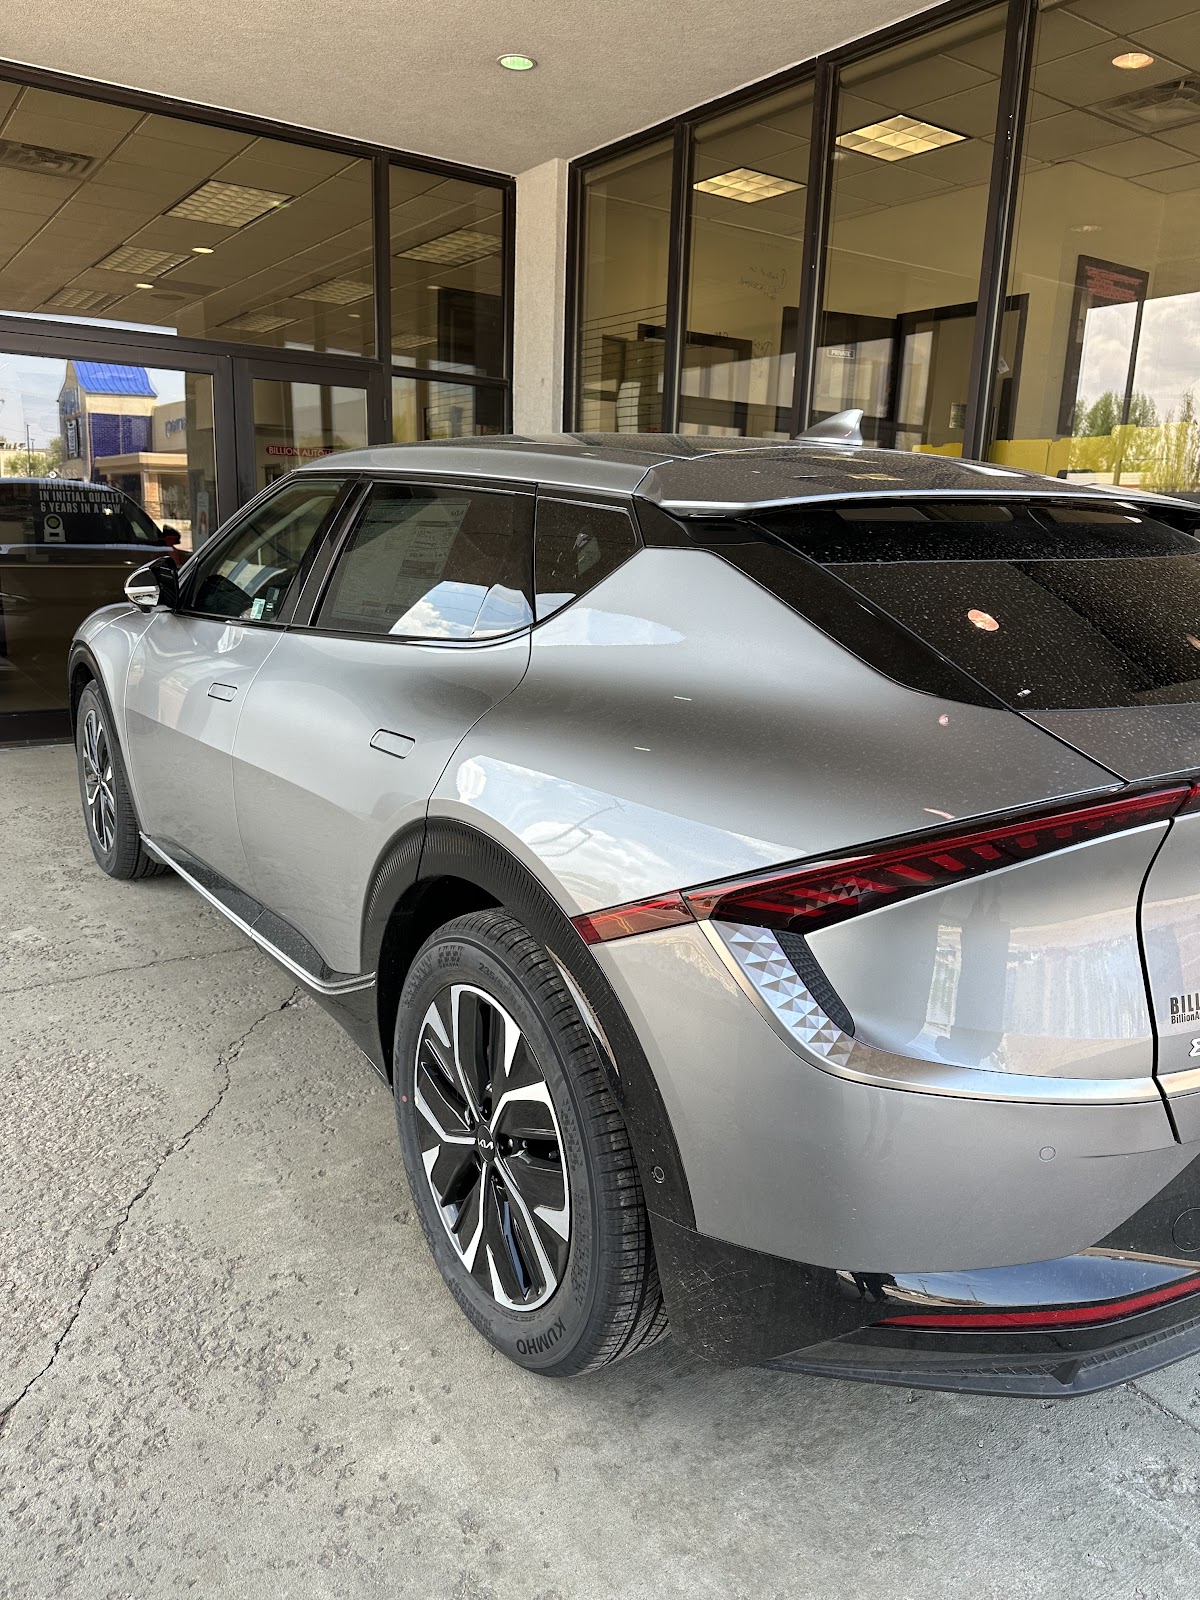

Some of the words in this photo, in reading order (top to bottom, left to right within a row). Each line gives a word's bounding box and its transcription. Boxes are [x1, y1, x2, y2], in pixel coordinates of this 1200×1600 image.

[268, 446, 300, 456] BILLION
[39, 491, 48, 501] IN
[52, 491, 87, 502] INITIAL
[89, 492, 127, 503] QUALITY,
[40, 502, 47, 513] 6
[50, 502, 79, 513] YEARS
[81, 503, 91, 513] IN
[93, 503, 99, 514] A
[516, 1316, 567, 1355] KUMHO
